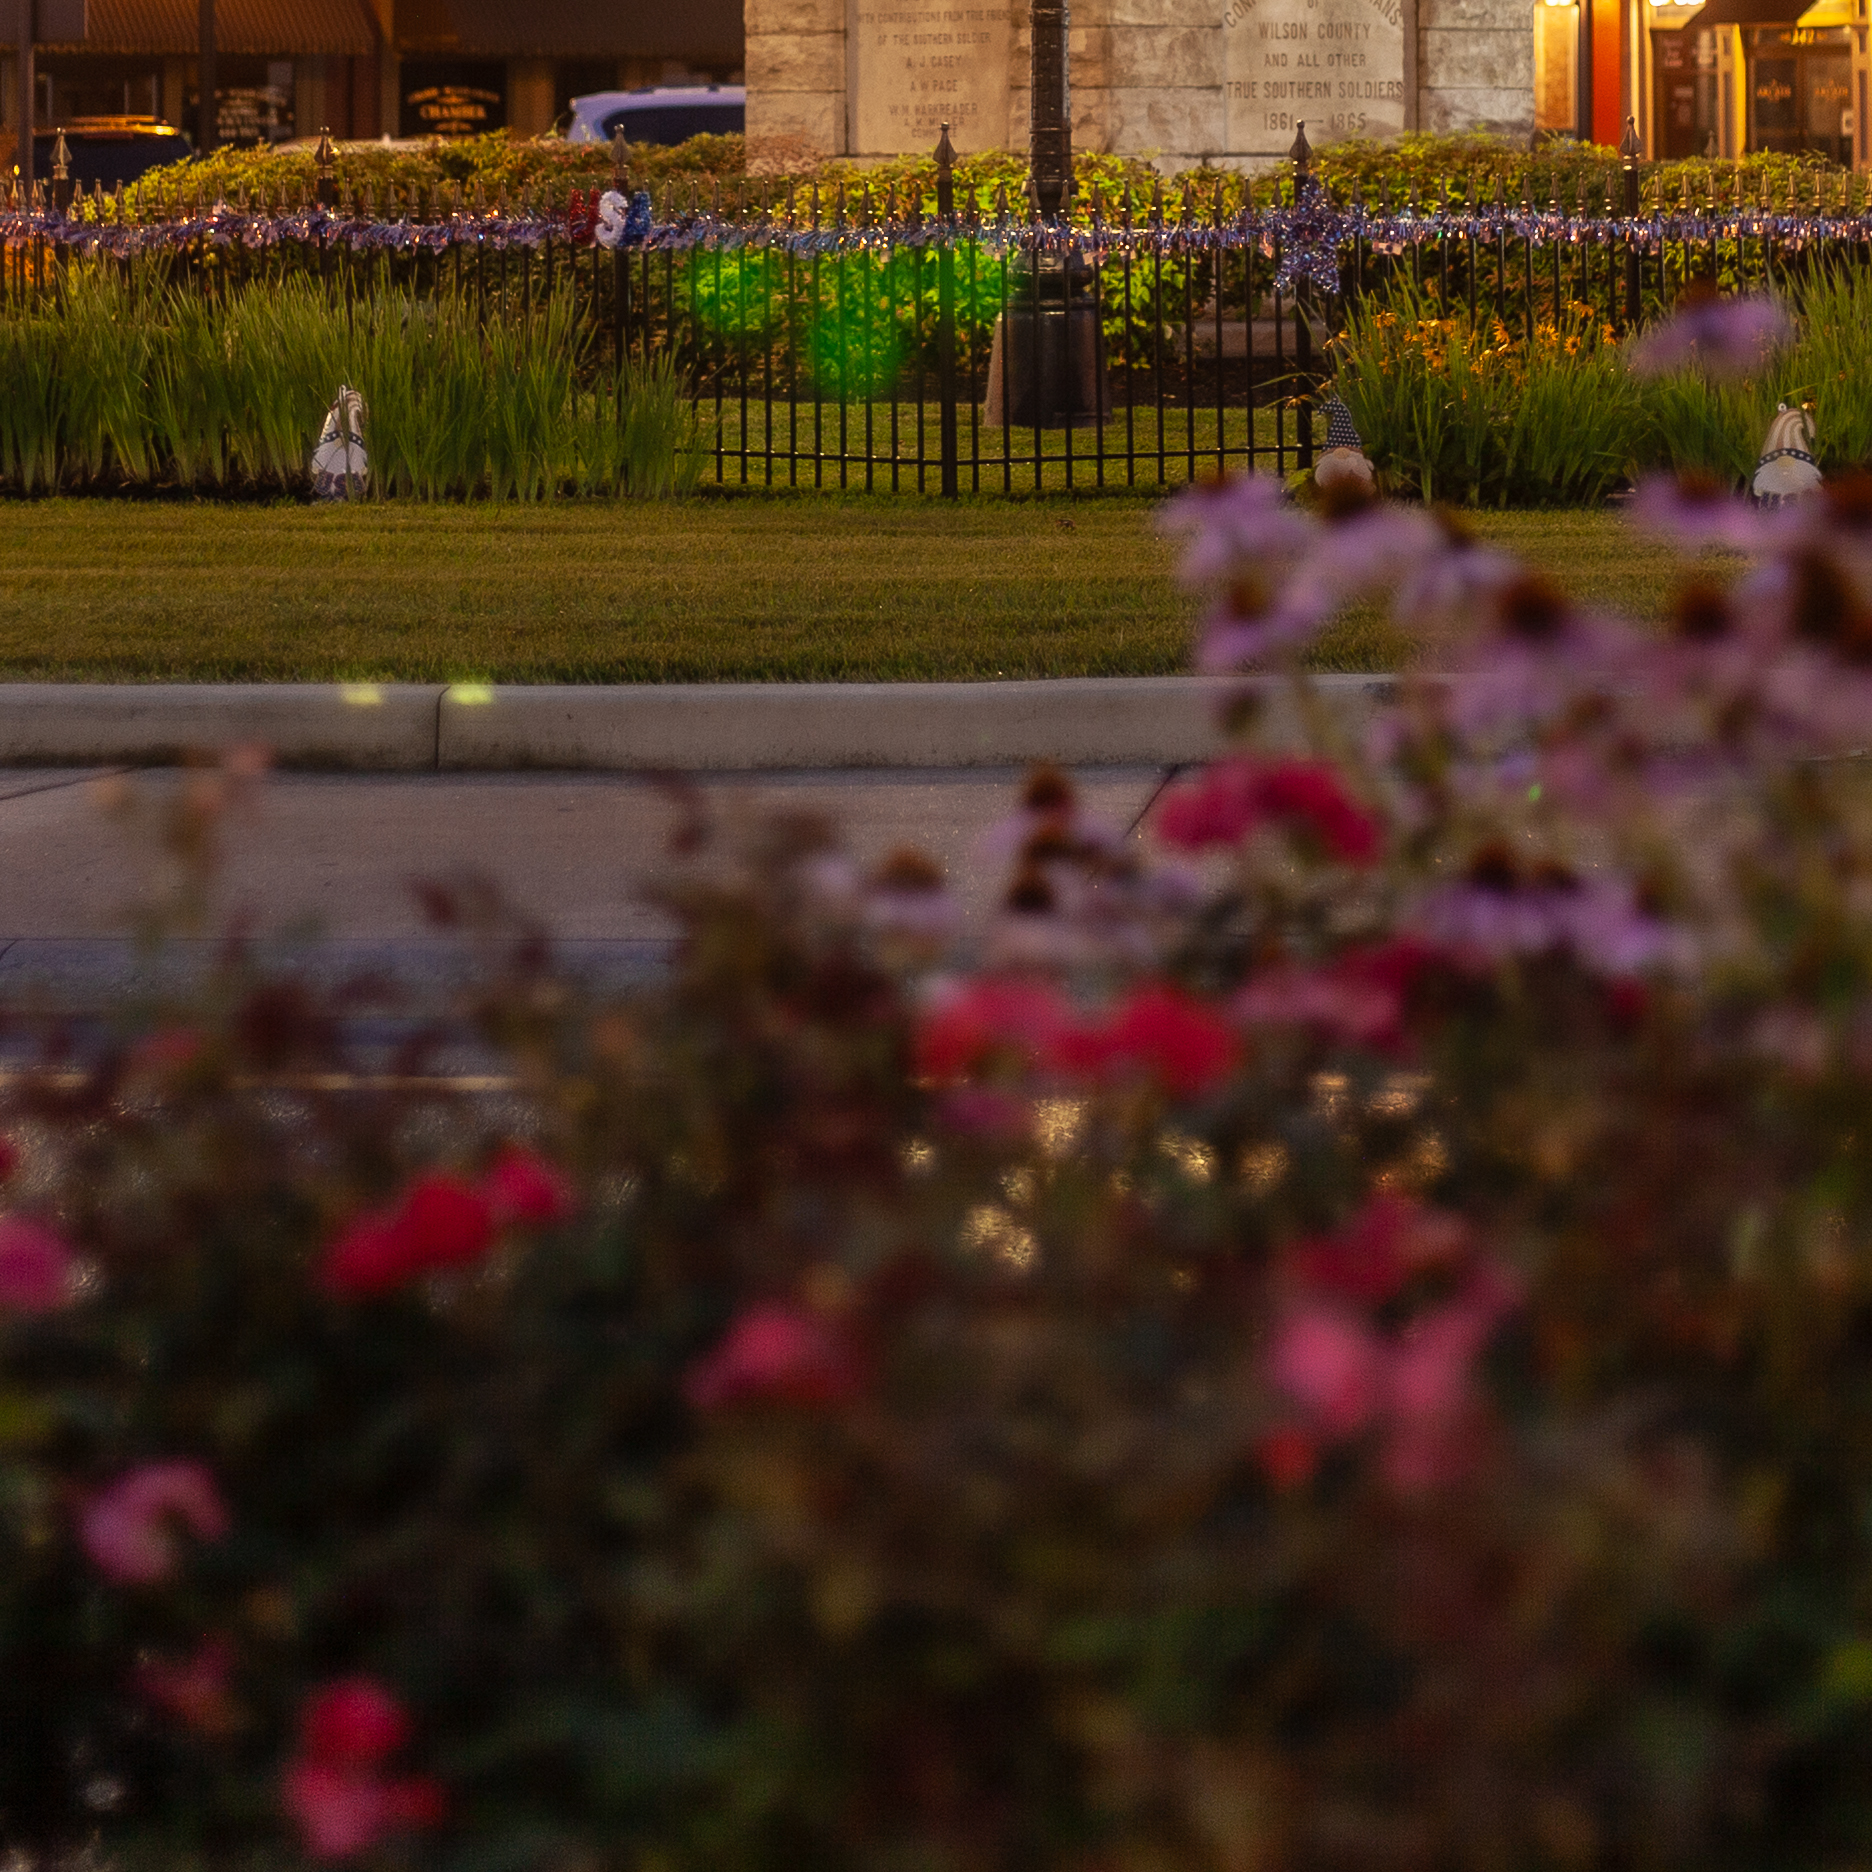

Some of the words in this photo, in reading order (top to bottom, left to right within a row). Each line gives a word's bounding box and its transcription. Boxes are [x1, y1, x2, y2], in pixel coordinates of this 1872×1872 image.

[1257, 21, 1308, 40] WILSON
[1317, 22, 1372, 40] COUNTY
[930, 54, 962, 68] CASEY
[1264, 53, 1288, 67] AND
[1296, 53, 1321, 67] ALL
[1328, 53, 1367, 67] OTHER
[1226, 81, 1258, 99] TRUE
[1263, 81, 1332, 99] SOUTHERN
[1338, 81, 1404, 99] SOLDIERS
[1263, 112, 1294, 131] 1861
[1330, 112, 1367, 131] 1865
[569, 188, 652, 248] USA
